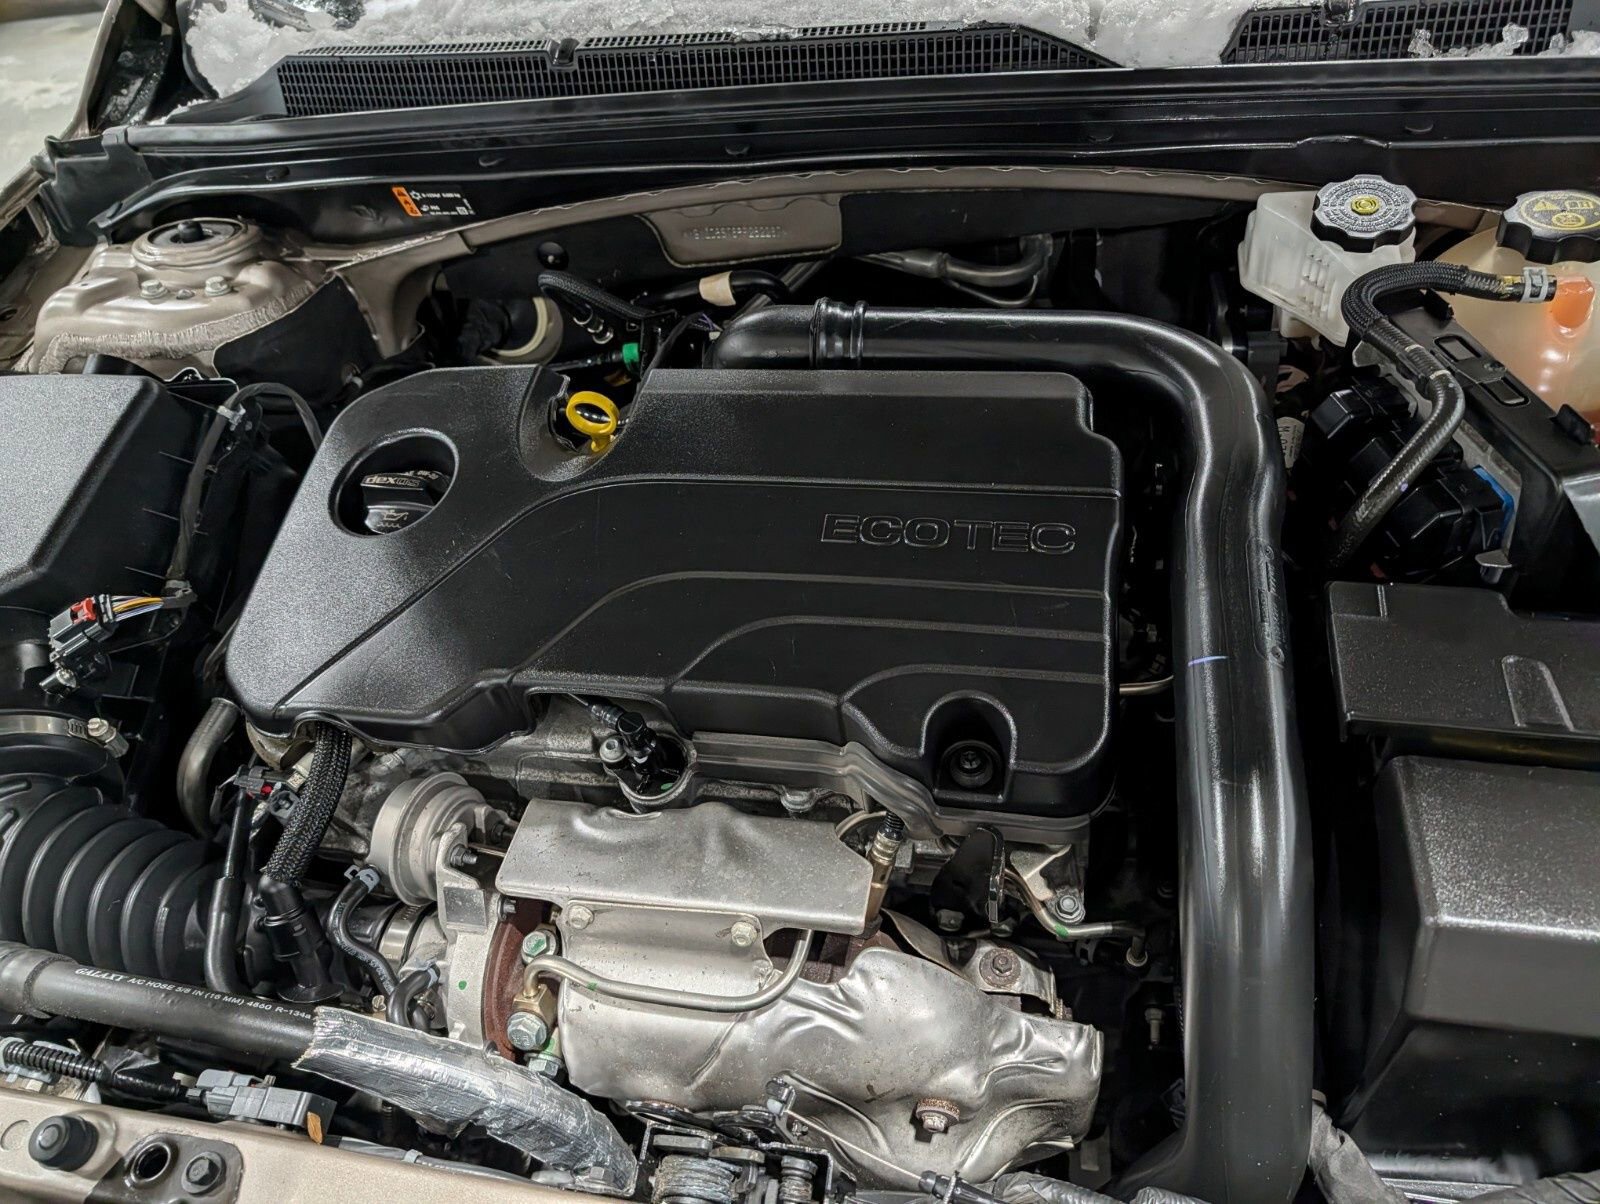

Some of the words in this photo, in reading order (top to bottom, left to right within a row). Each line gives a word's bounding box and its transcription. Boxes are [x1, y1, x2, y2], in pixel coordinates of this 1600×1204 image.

[365, 475, 420, 487] dexos
[820, 513, 1076, 555] ECOTEC
[75, 967, 128, 982] GALAXY
[127, 977, 146, 985] A/C
[146, 981, 175, 991] HOSE
[175, 986, 191, 994] 5/8
[192, 989, 205, 997] IN
[204, 991, 221, 1000] (16
[222, 995, 245, 1006] MM)
[275, 1006, 312, 1020] R-134a
